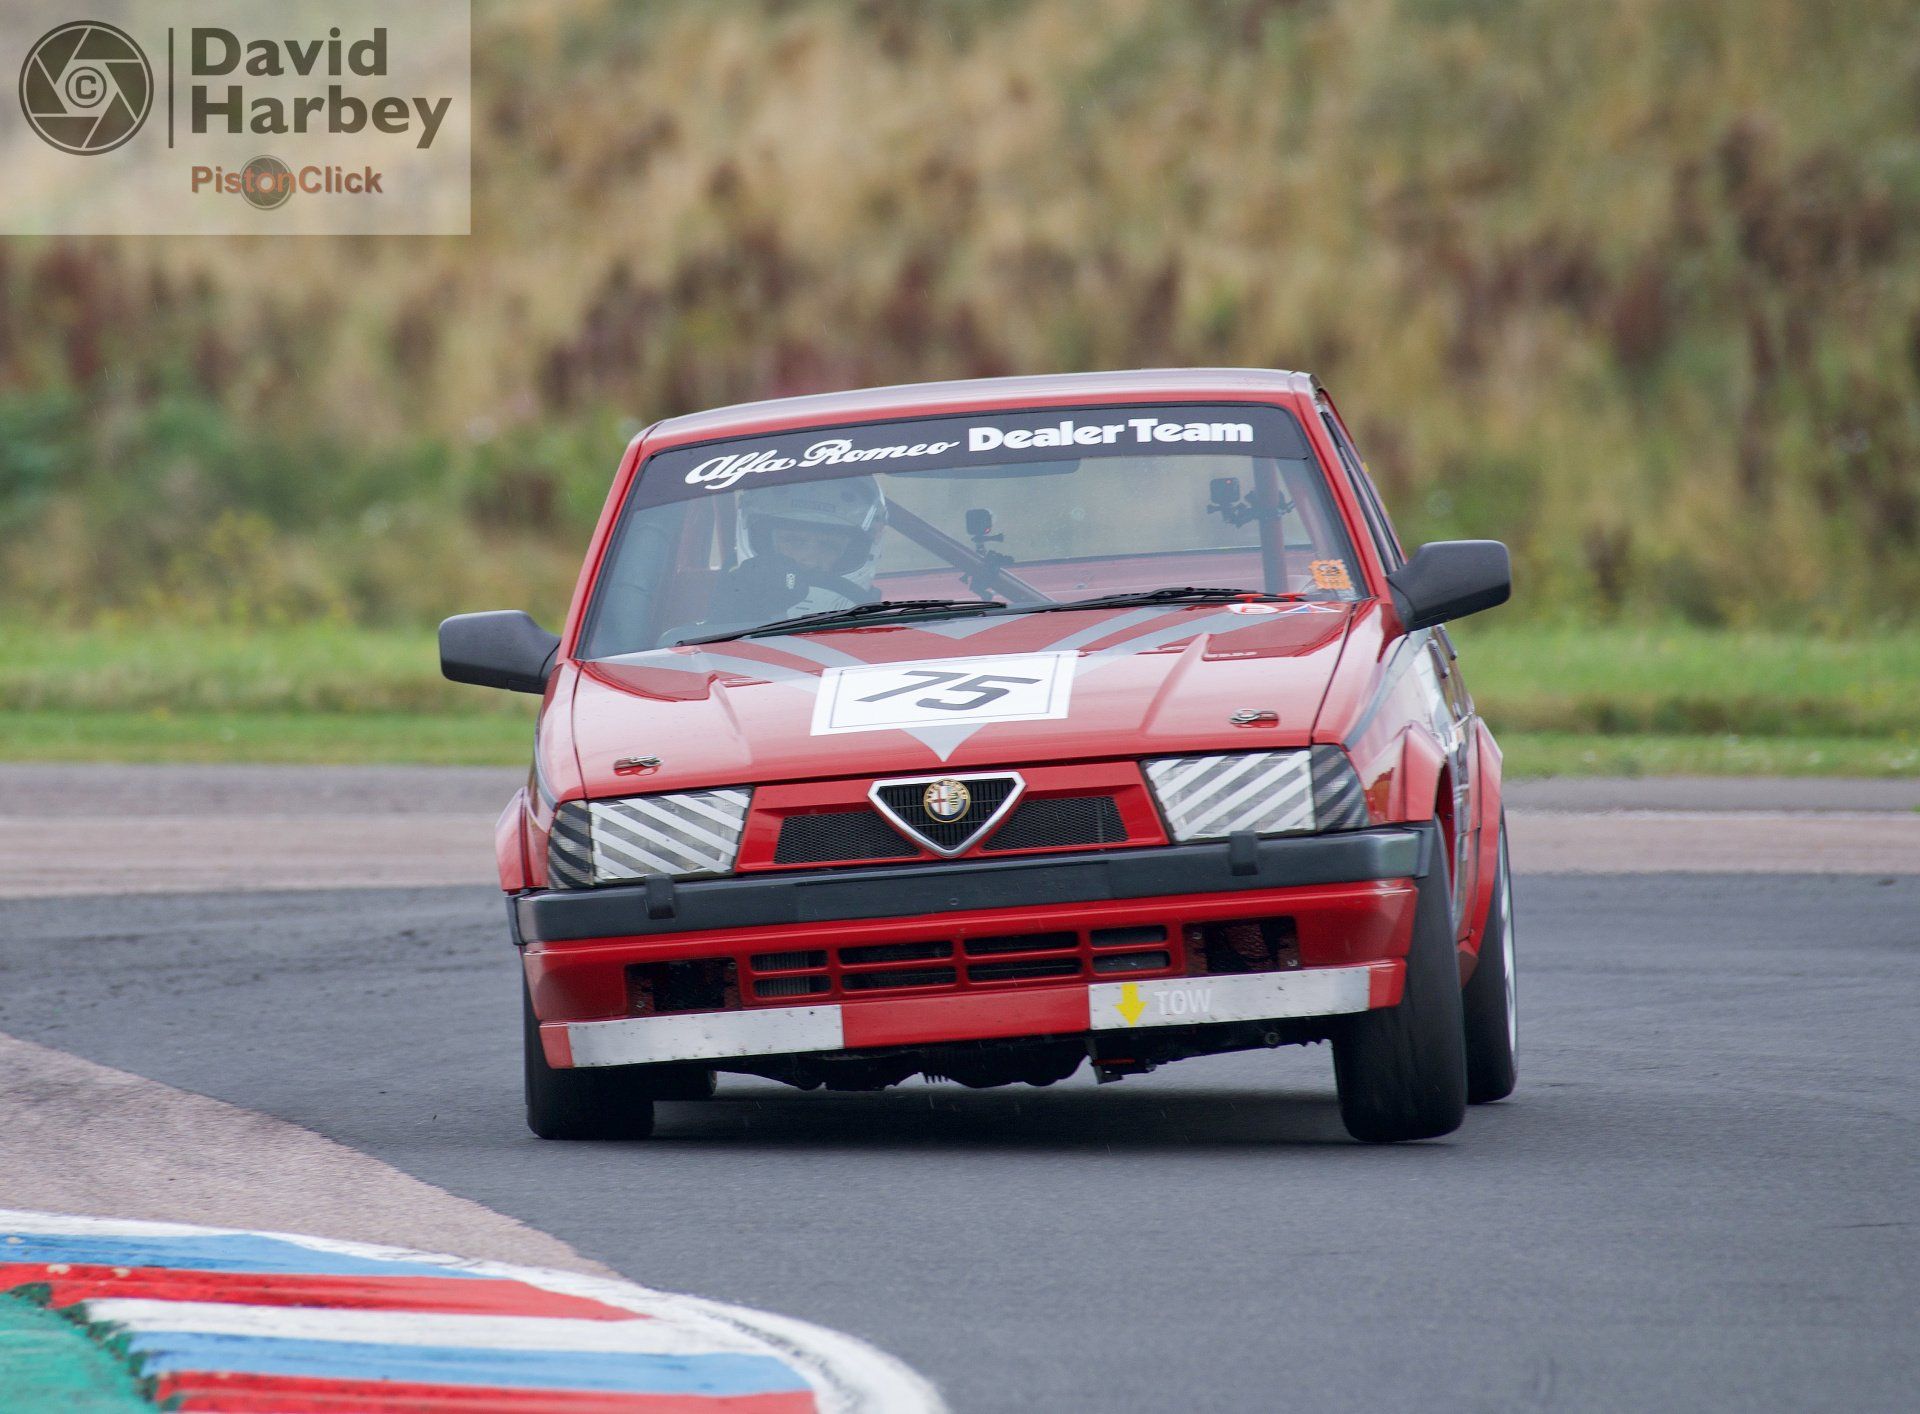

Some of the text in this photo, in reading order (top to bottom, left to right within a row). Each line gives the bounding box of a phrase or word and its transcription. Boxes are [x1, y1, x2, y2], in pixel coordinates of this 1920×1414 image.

[684, 418, 1254, 490] Alfa Romeo Dealer Team
[853, 670, 1043, 711] 75
[1153, 988, 1212, 1016] TOW
